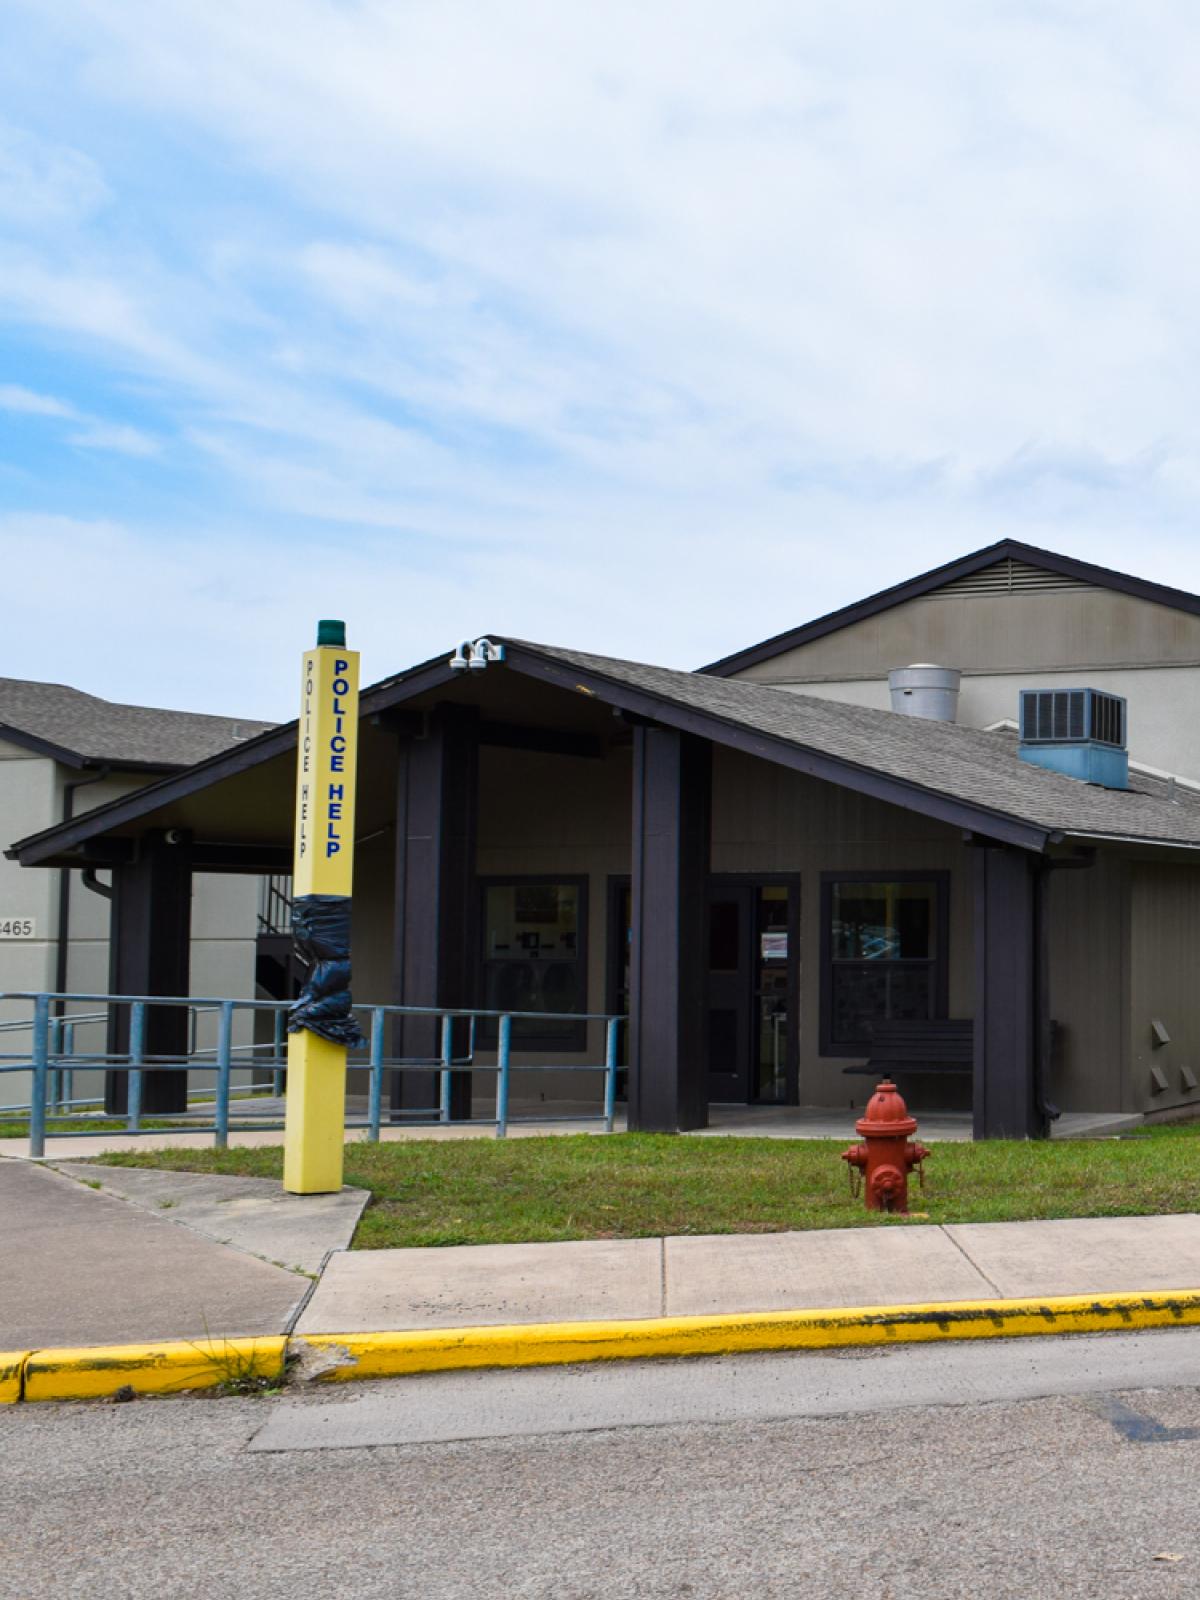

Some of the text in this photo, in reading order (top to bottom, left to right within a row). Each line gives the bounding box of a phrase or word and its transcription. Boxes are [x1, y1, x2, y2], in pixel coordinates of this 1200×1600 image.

[300, 660, 313, 858] POLICE HELP
[326, 660, 349, 857] POLICE HELP
[0, 920, 32, 936] 465
